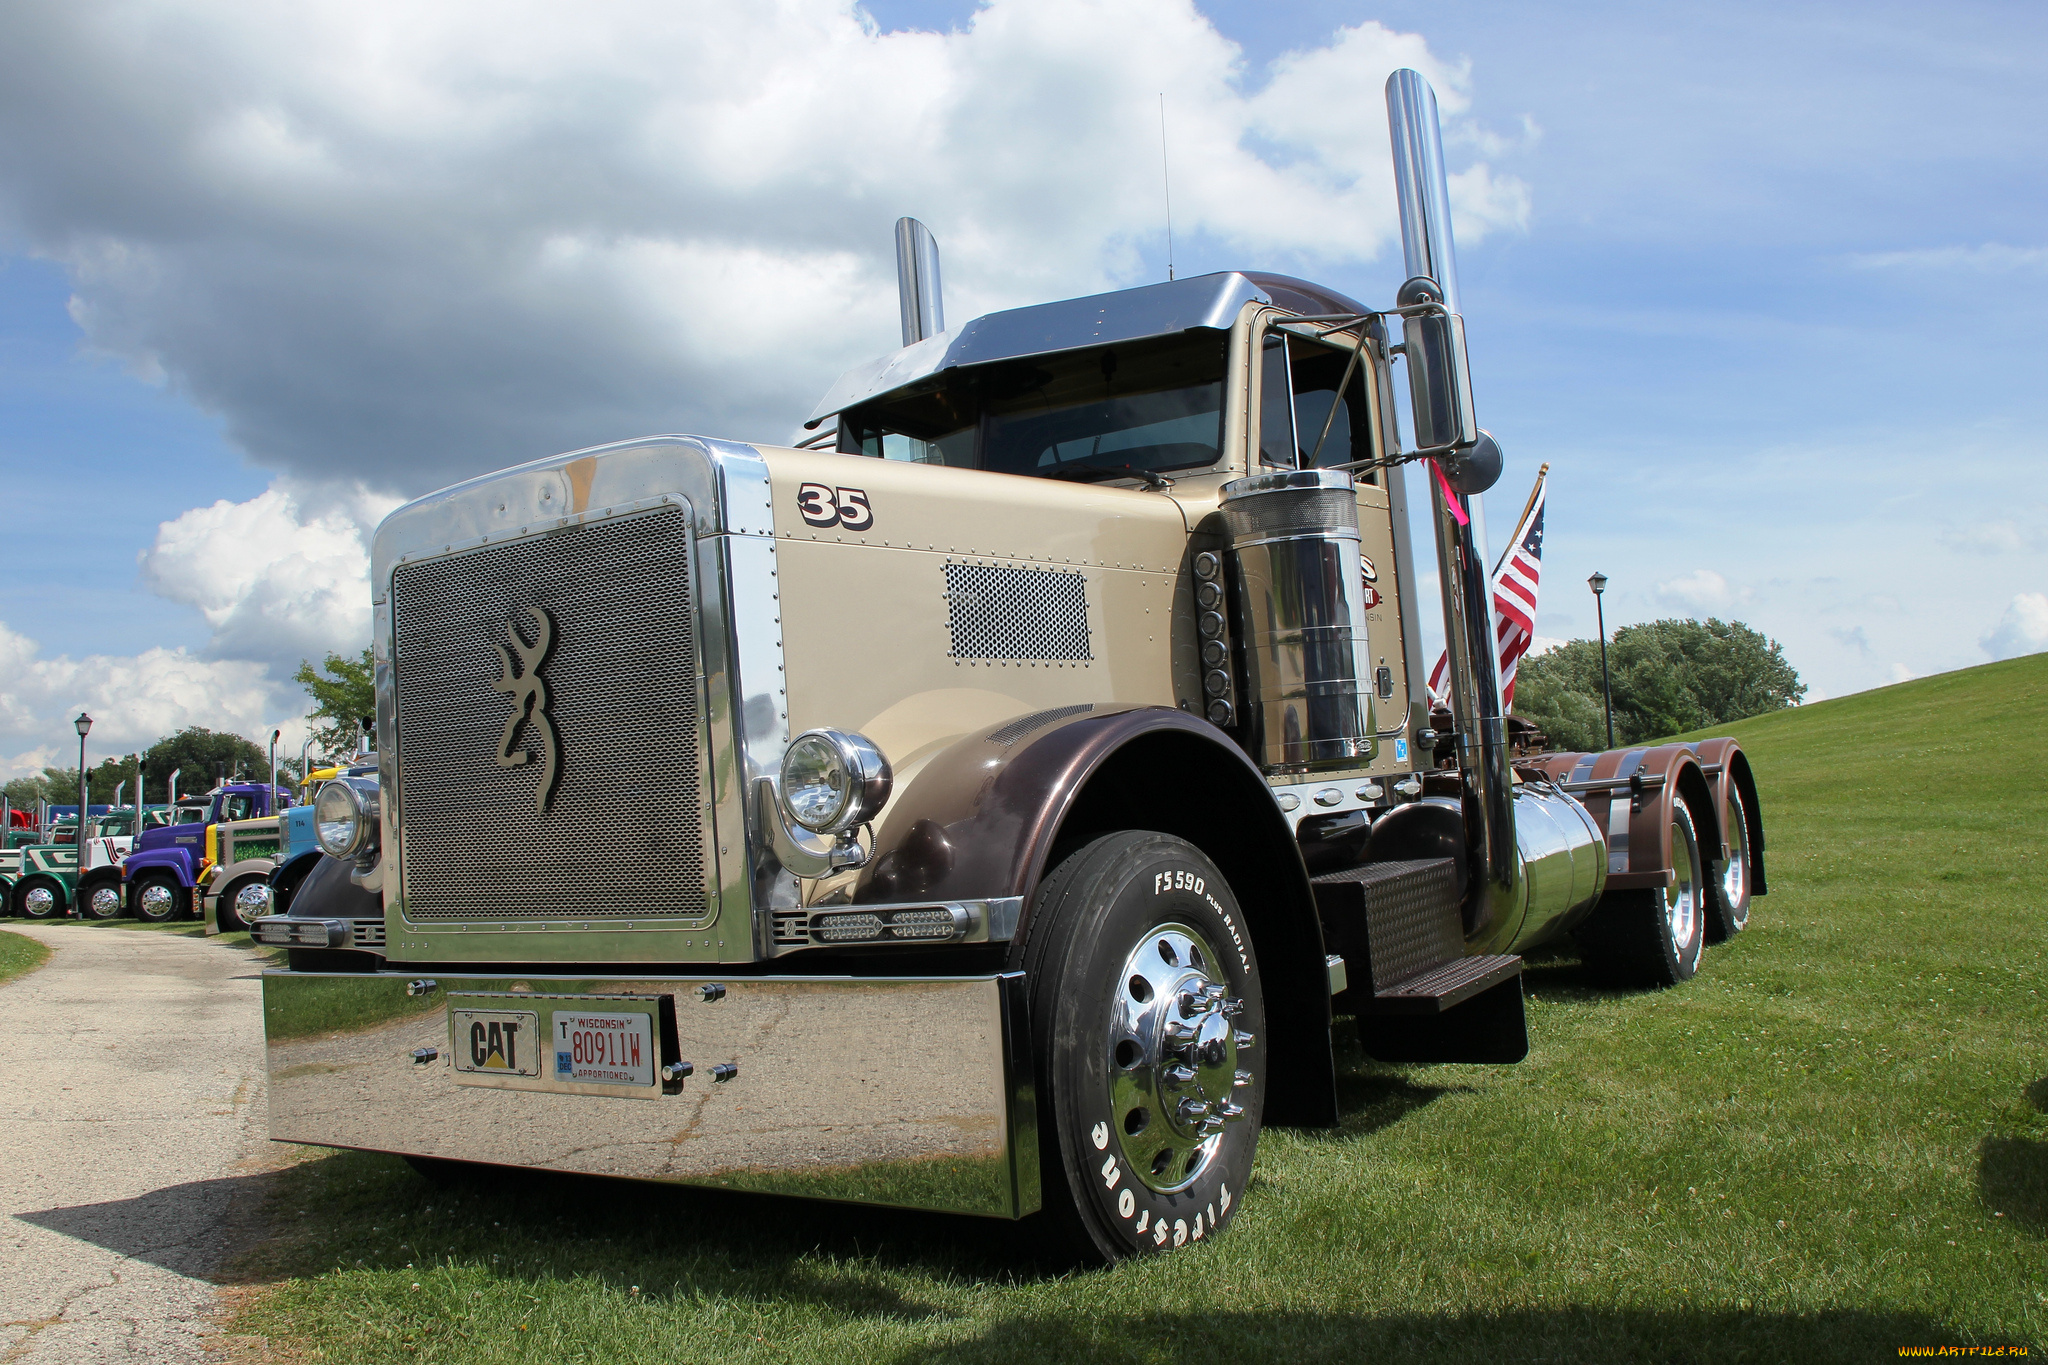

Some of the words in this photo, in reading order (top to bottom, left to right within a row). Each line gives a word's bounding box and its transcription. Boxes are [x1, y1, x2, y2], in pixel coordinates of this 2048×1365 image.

[797, 482, 874, 532] 35
[1206, 893, 1223, 915] PLUS
[1223, 913, 1251, 974] RADIAL
[560, 1021, 568, 1039] T
[577, 1018, 625, 1029] WISCONSIN
[470, 1021, 518, 1069] CAT
[572, 1030, 640, 1067] 80911W
[578, 1069, 629, 1080] APPORTIONED
